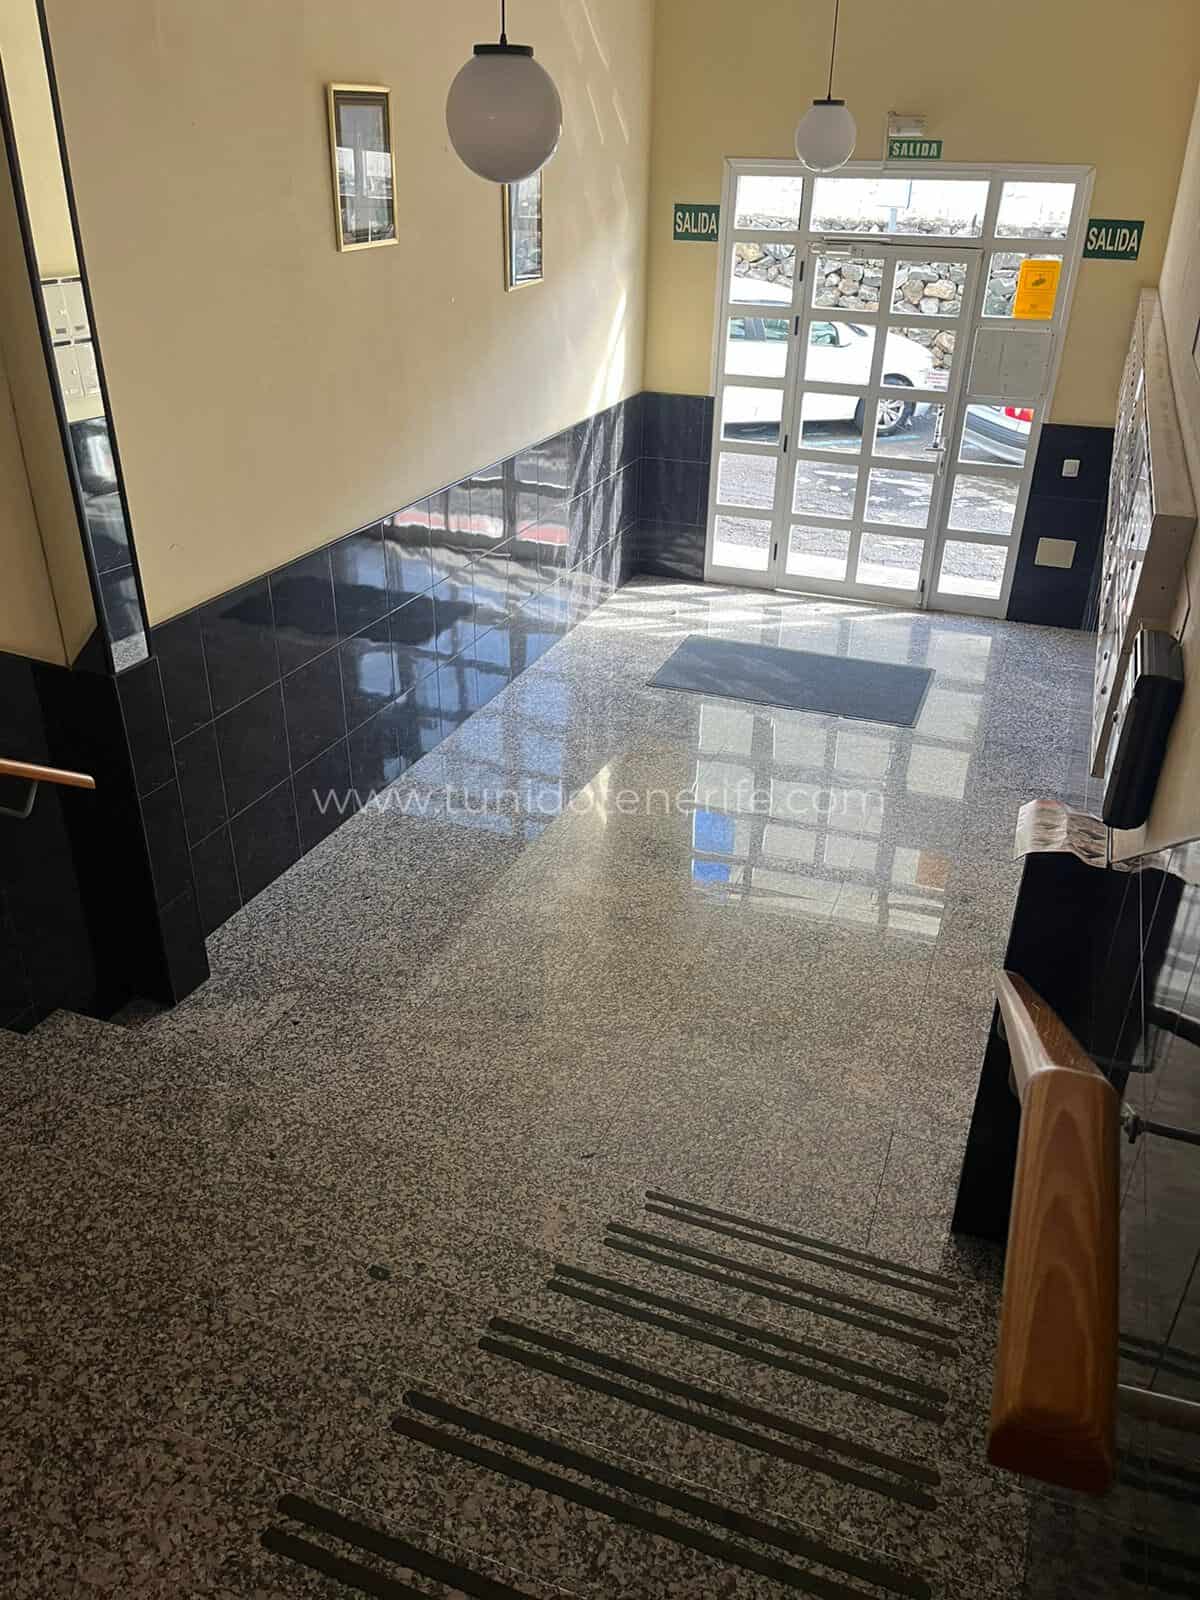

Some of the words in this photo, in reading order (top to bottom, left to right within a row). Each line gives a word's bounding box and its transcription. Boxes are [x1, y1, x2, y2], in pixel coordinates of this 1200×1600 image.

[892, 142, 937, 156] SALIDA
[675, 211, 717, 234] SALIDA
[1087, 227, 1139, 252] SALIDA
